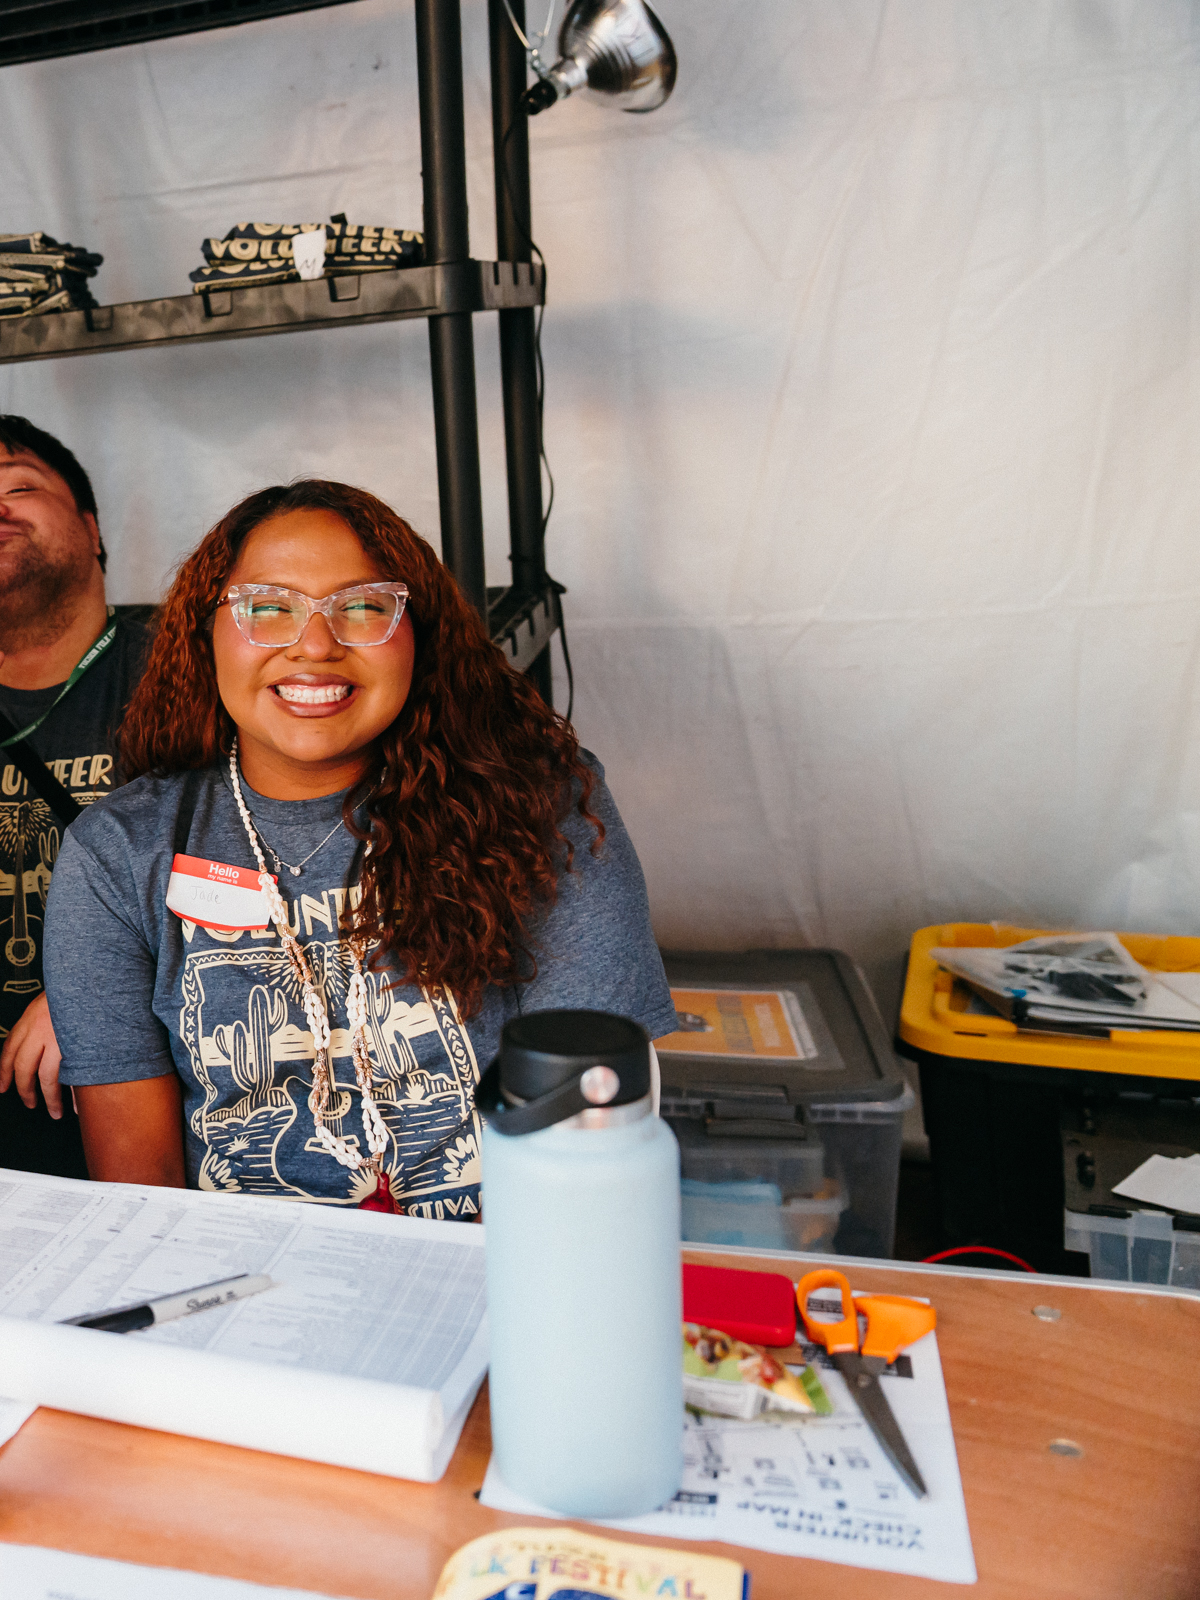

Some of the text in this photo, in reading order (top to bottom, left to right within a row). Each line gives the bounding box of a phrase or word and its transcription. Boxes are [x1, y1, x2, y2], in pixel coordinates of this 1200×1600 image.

[209, 238, 404, 262] VOLUEER
[207, 873, 217, 881] my
[216, 875, 232, 884] name
[208, 863, 240, 879] Hello
[190, 885, 221, 904] Jade
[401, 1191, 482, 1220] STIVA
